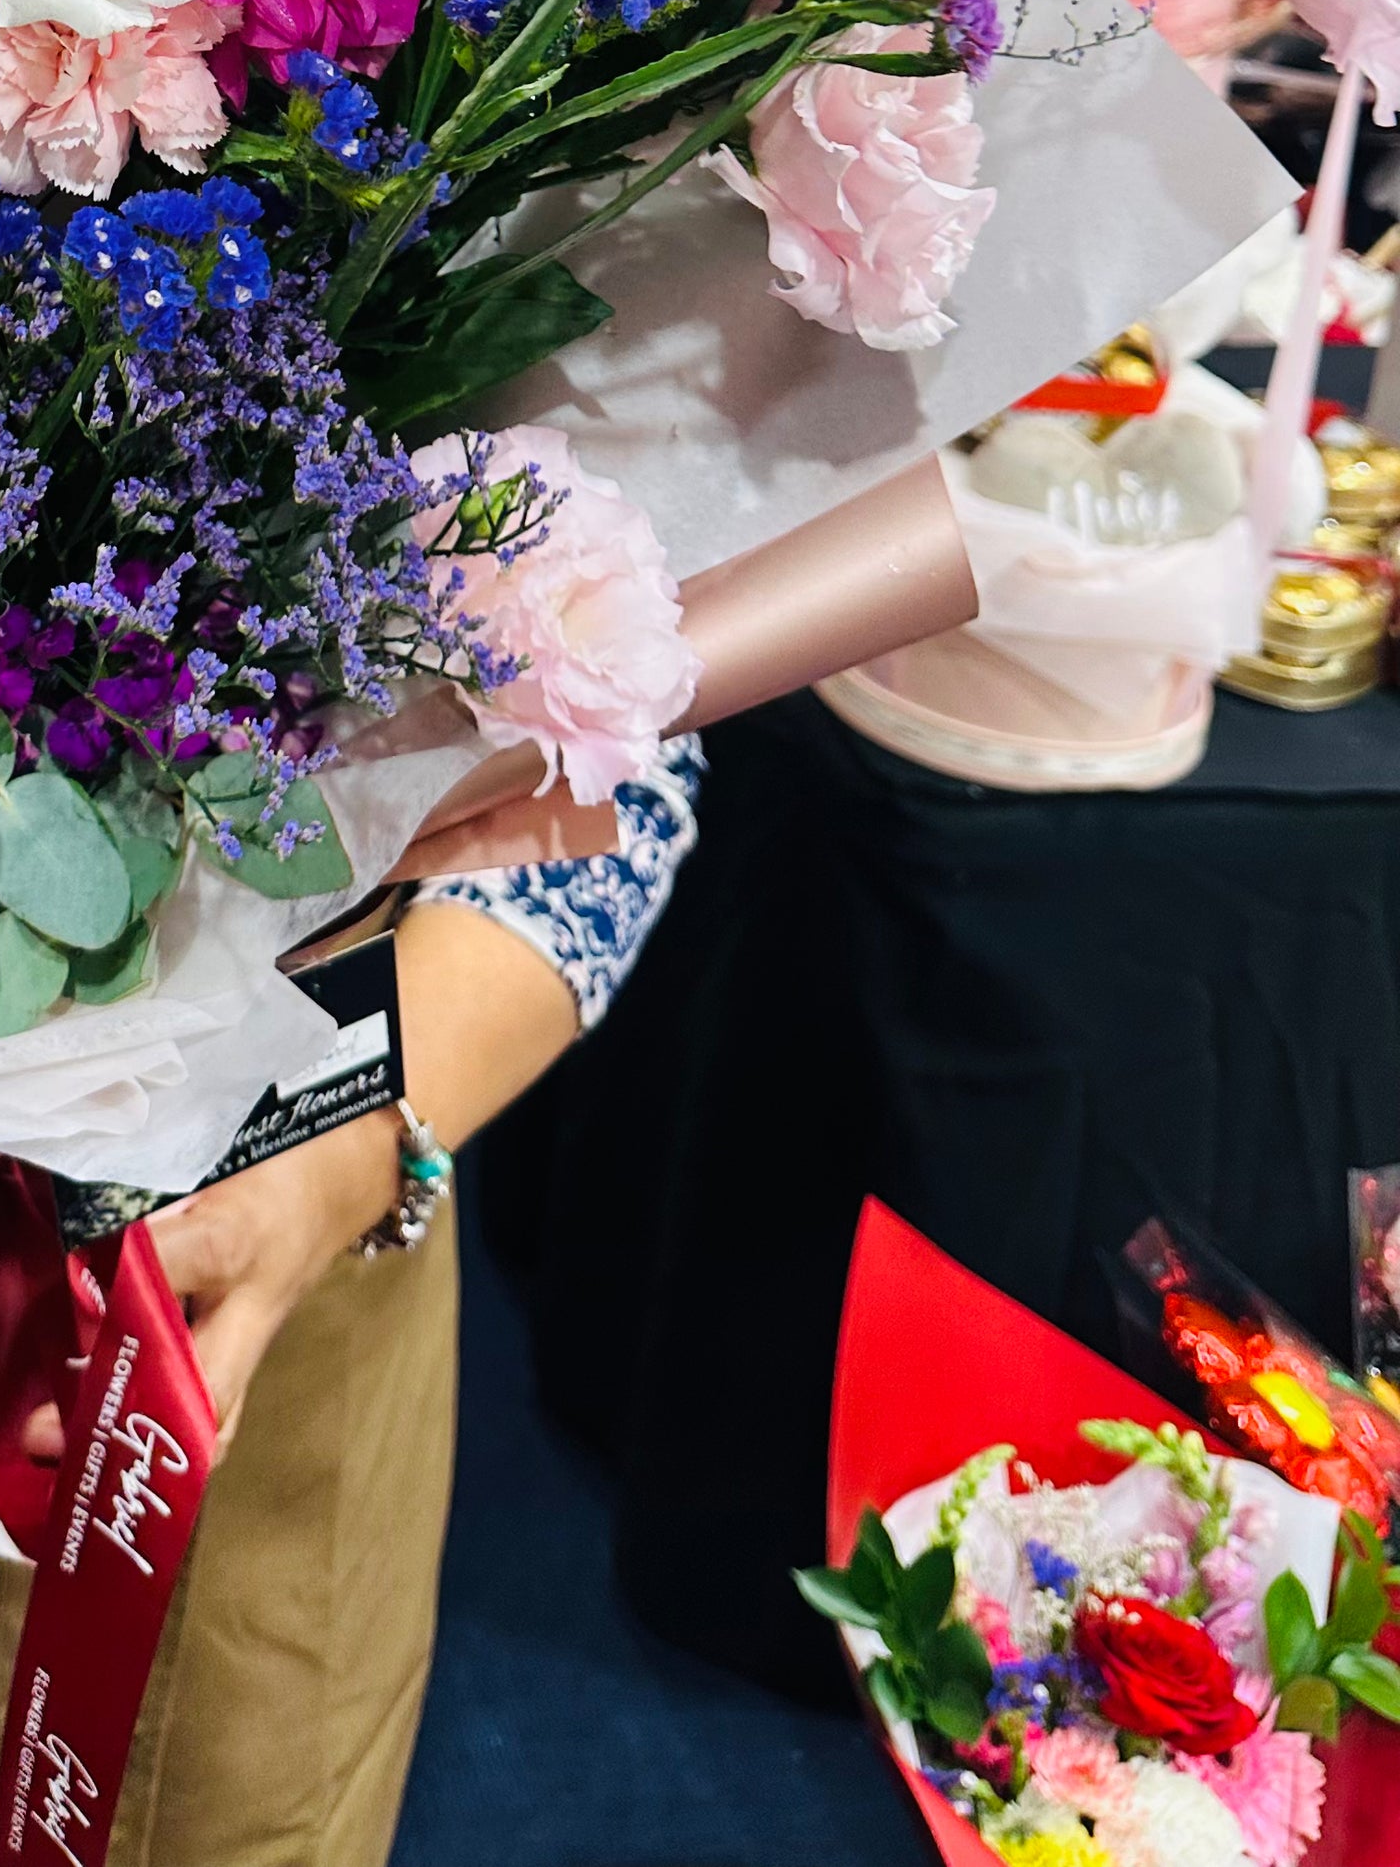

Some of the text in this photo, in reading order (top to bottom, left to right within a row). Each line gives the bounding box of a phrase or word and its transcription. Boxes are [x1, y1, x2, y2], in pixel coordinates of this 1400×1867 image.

[282, 1063, 389, 1132] flowers
[59, 1334, 140, 1575] FLOWERS GIFTS EVENTS
[92, 1412, 190, 1576] Gabriel
[30, 1733, 99, 1867] Gabriel
